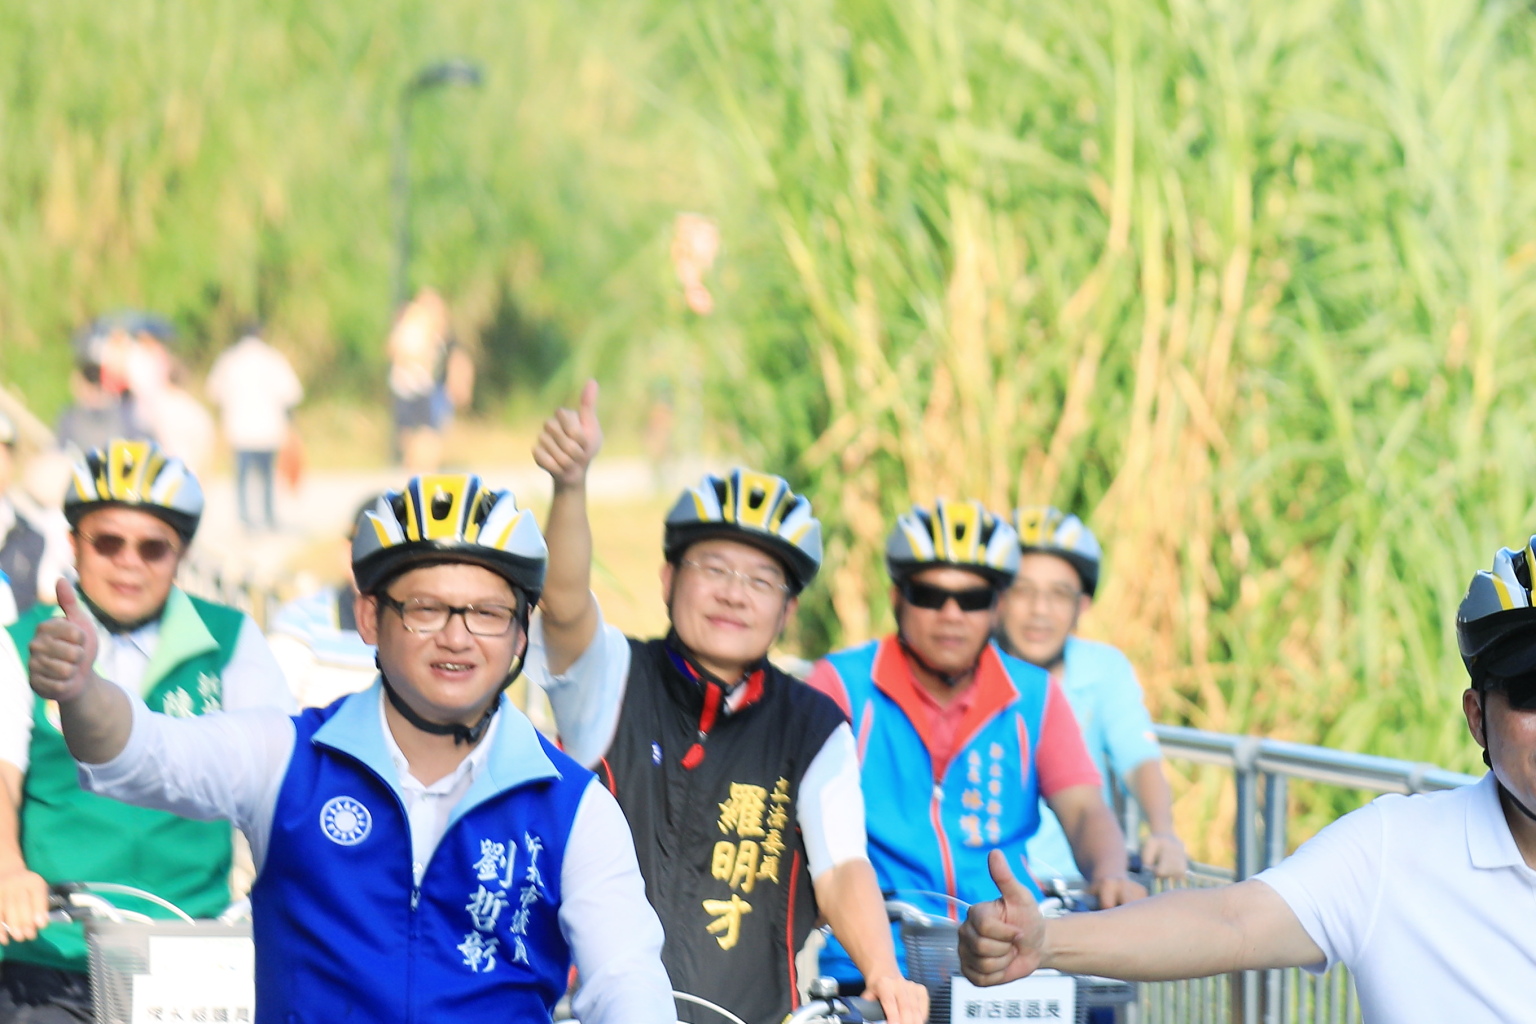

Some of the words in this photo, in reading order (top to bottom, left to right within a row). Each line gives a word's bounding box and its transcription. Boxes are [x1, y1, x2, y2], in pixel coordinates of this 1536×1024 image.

[457, 838, 518, 973] 劉哲彰
[702, 781, 769, 951] 羅明才
